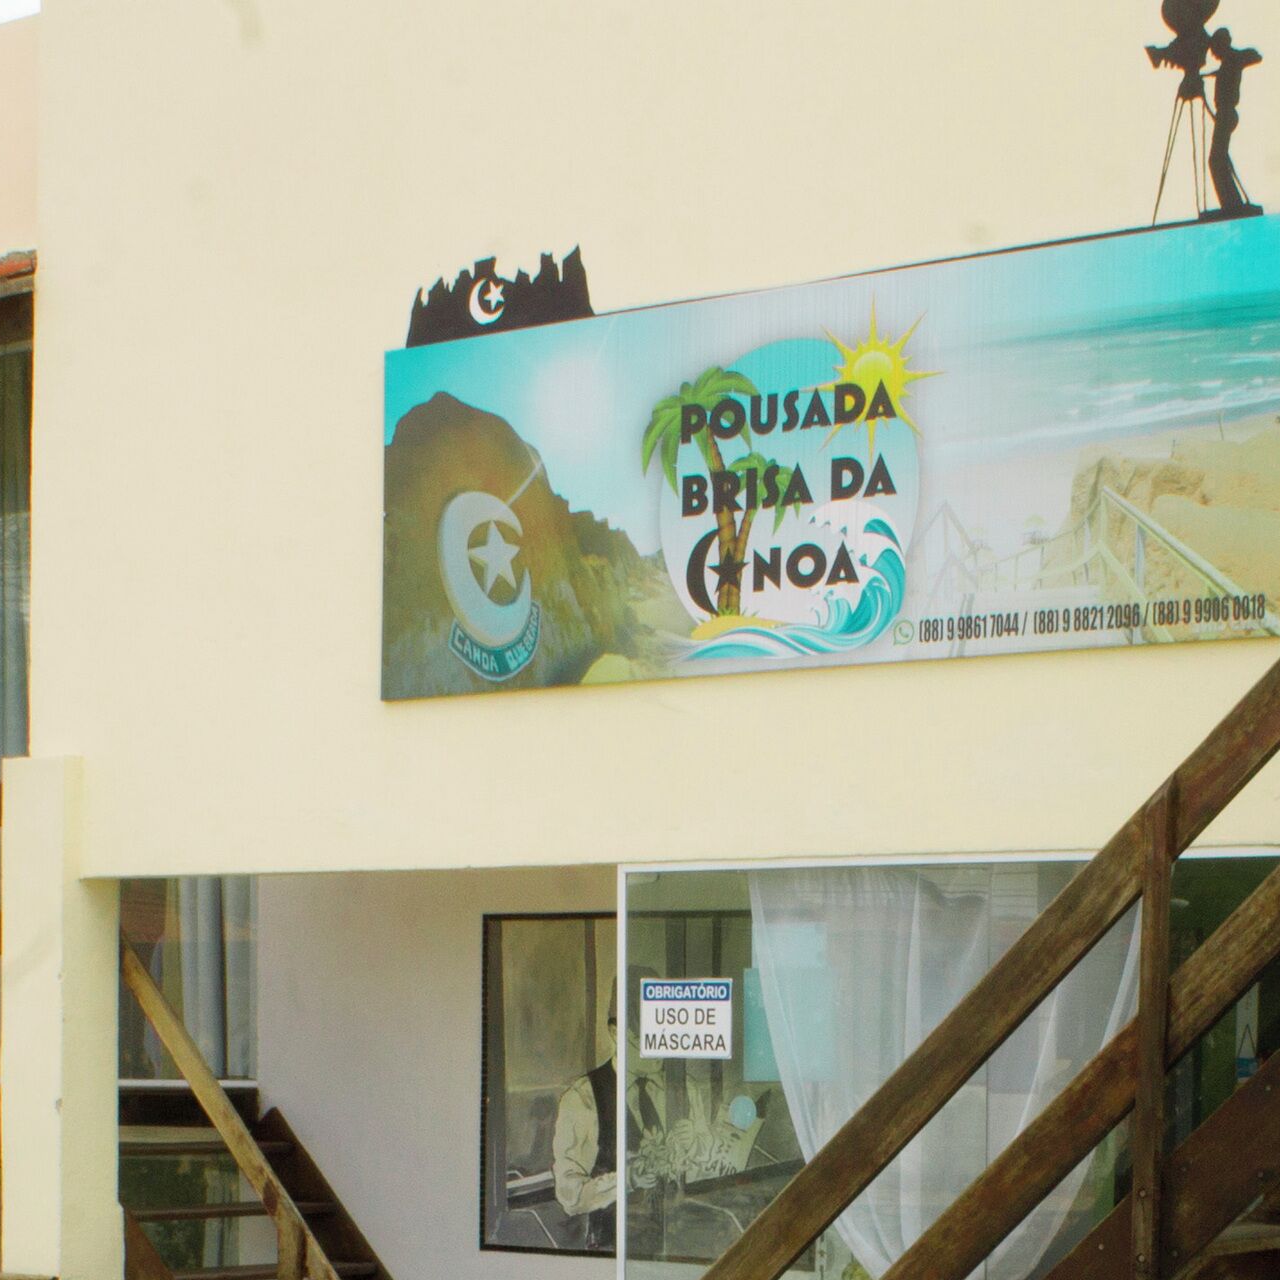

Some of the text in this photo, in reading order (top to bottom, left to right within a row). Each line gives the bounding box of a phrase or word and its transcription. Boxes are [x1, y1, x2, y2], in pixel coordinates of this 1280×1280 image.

[680, 378, 897, 445] POUSADA
[681, 452, 897, 518] BRISA DA
[919, 617, 944, 643] (88)
[947, 617, 954, 640] 9
[1034, 608, 1059, 634] (88)
[1062, 608, 1070, 632] 9
[1152, 600, 1179, 626] (88)
[1183, 599, 1191, 624] 9
[454, 627, 500, 673] CANOA
[645, 983, 727, 999] OBRIGATÓRIO
[655, 1007, 717, 1025] USO DE
[644, 1028, 727, 1051] MÁSCARA
